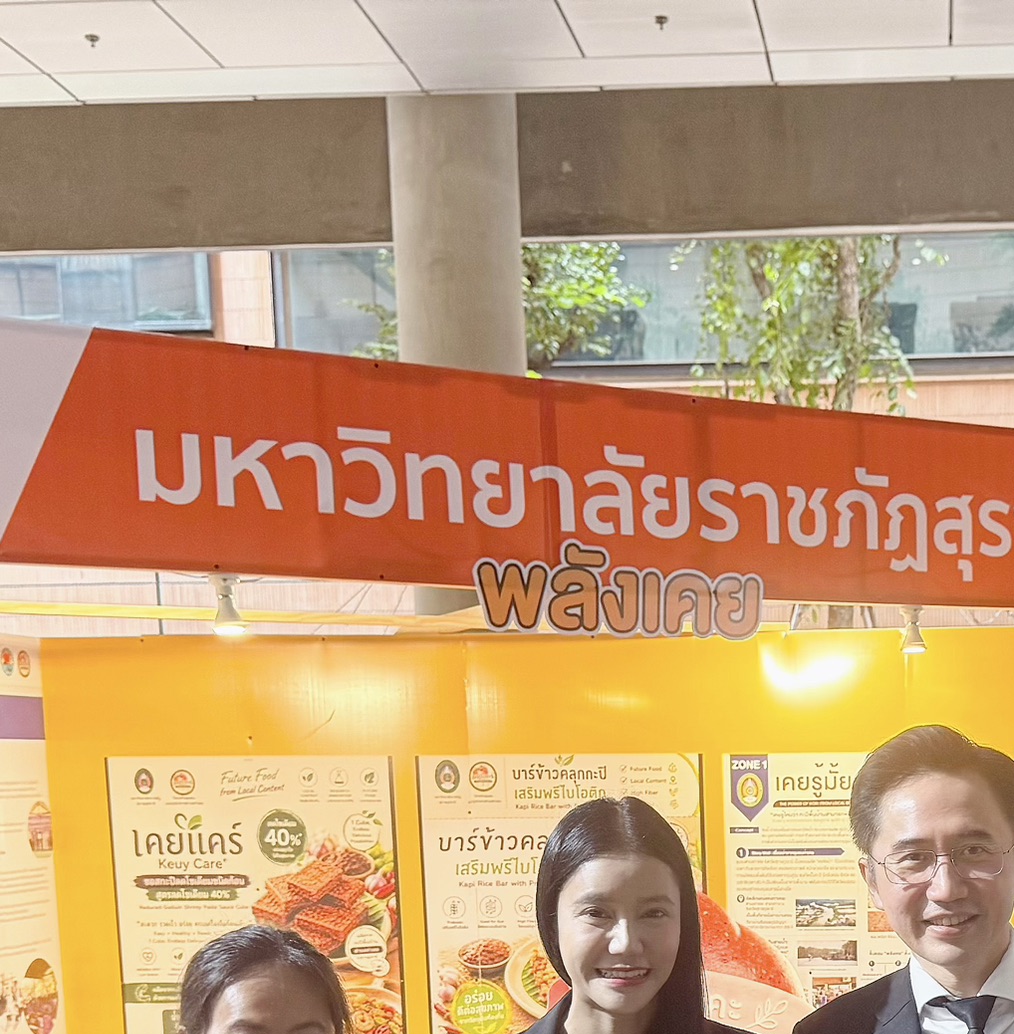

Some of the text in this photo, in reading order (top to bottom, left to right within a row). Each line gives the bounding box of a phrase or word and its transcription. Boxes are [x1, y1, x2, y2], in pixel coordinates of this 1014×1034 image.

[475, 541, 763, 640] พลังเคย
[731, 760, 761, 770] ZONE
[220, 767, 280, 785] Future Food
[158, 858, 190, 872] Keuy
